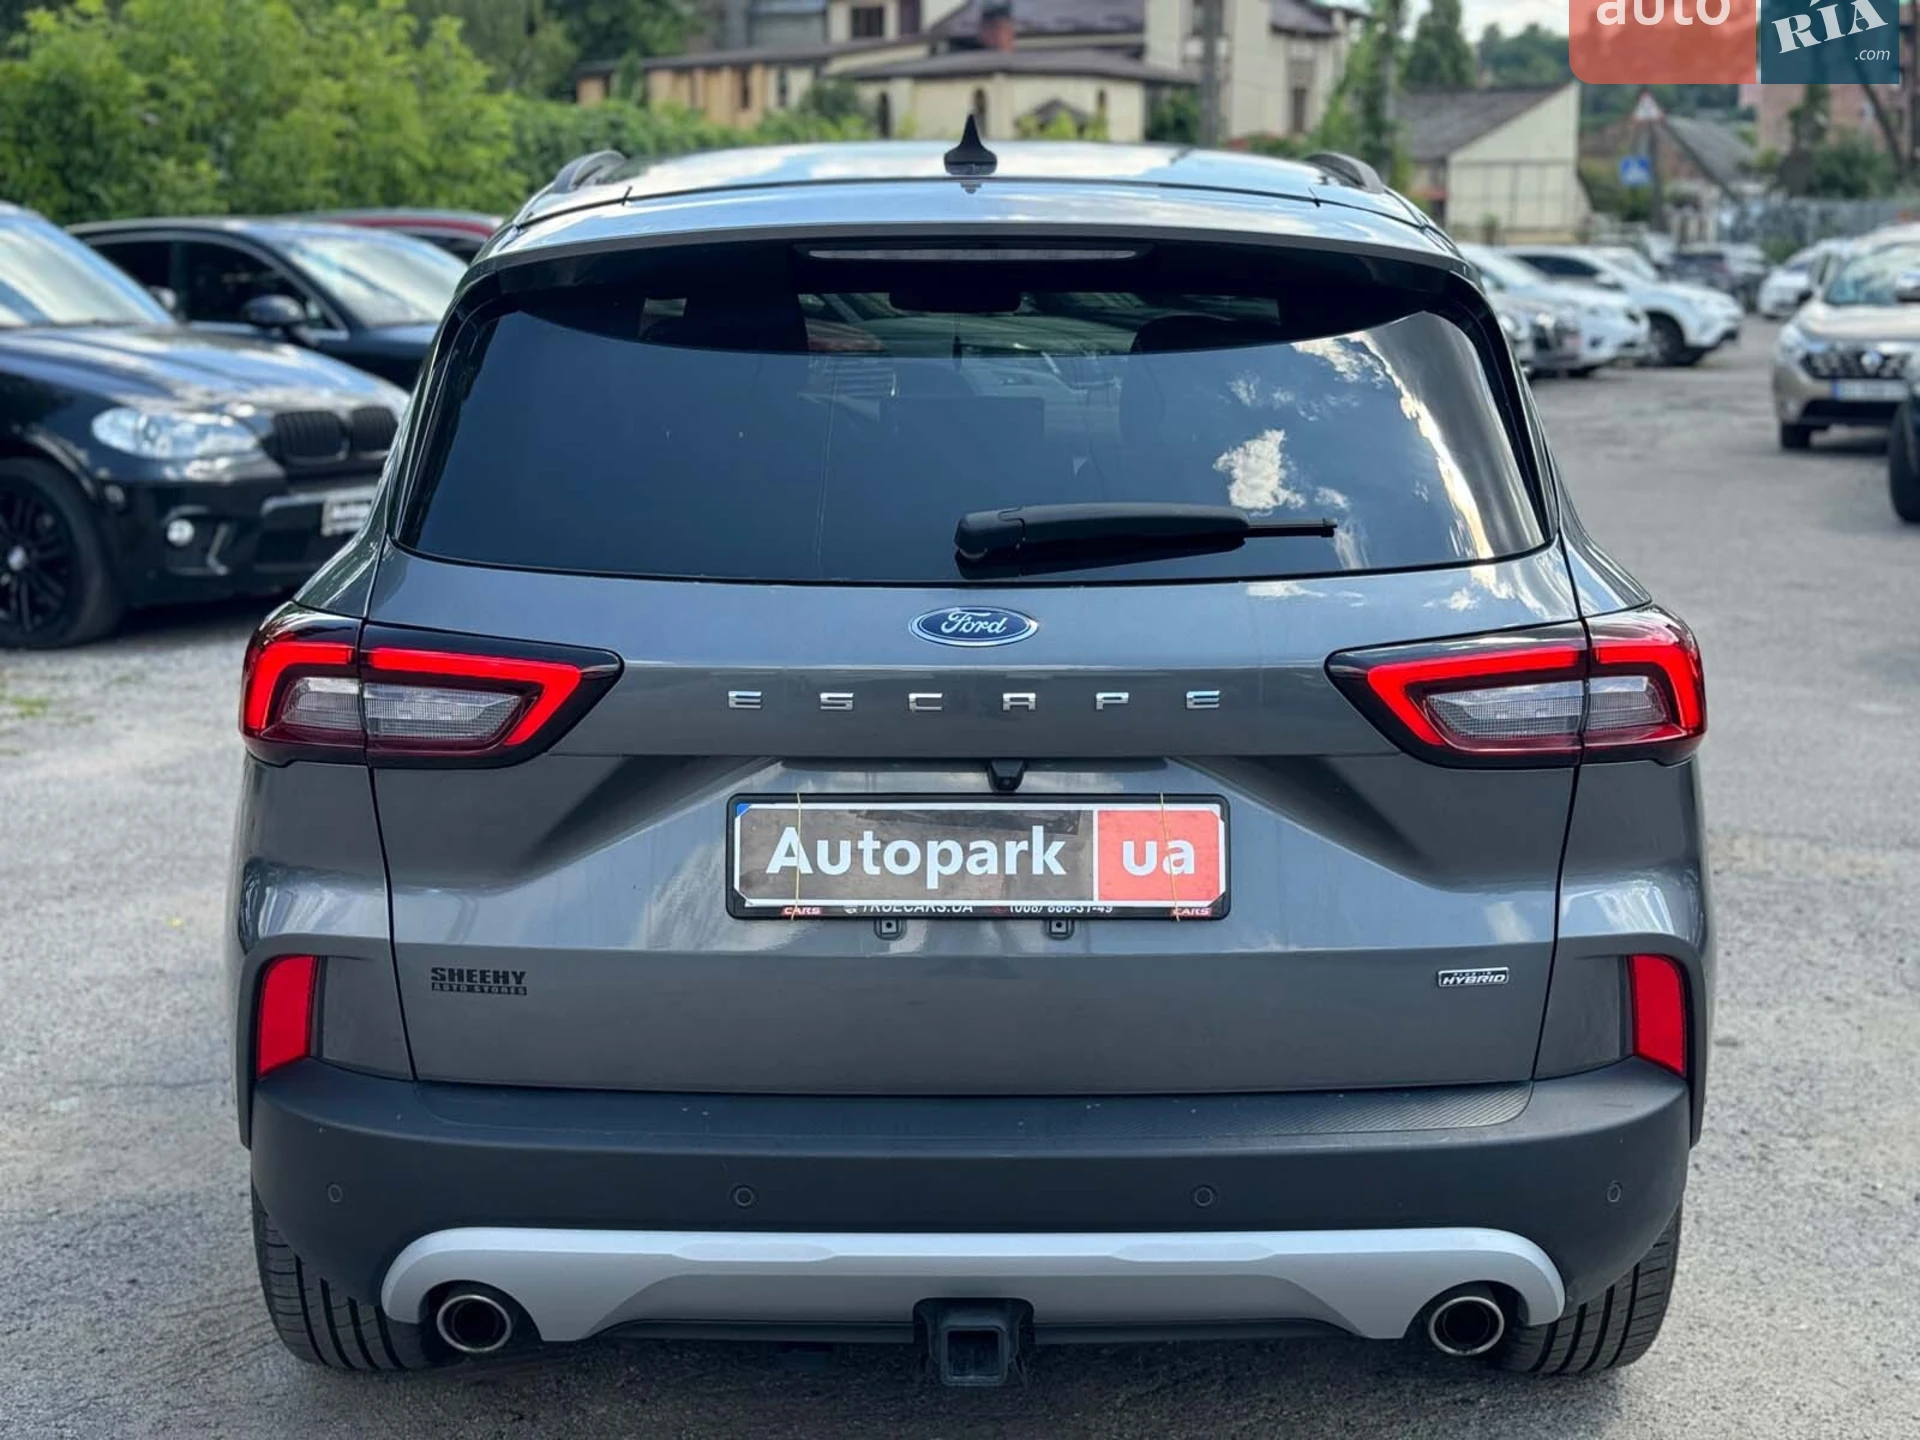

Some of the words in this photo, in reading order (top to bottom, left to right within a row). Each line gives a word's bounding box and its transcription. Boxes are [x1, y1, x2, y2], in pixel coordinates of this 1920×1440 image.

[940, 609, 1007, 635] Ford
[728, 690, 1221, 712] ESCAPE
[765, 825, 1068, 890] Autopark
[1121, 838, 1197, 876] ua
[783, 906, 822, 916] CARS
[1172, 906, 1211, 917] CARS
[431, 967, 527, 985] SHEEHY
[1442, 974, 1506, 985] HYBRID
[433, 983, 468, 992] AUTO
[473, 985, 527, 995] STORES
